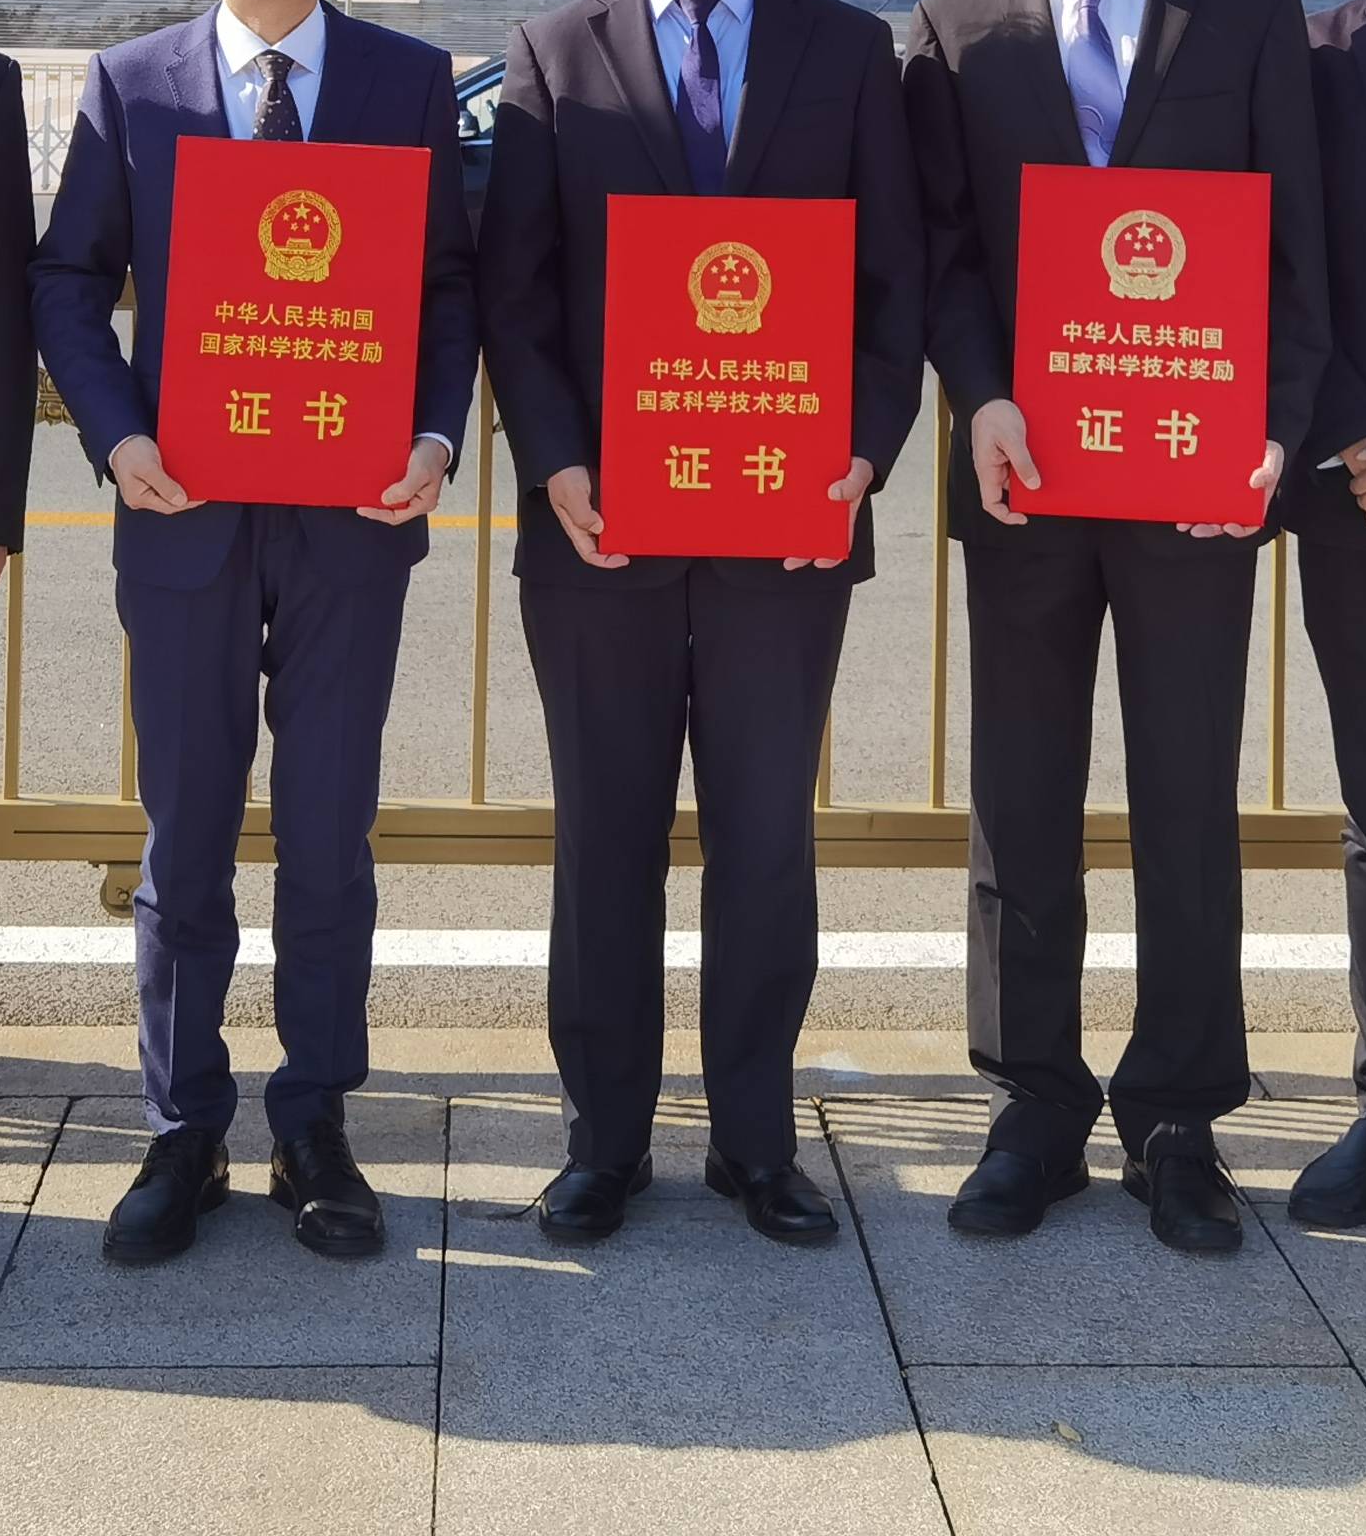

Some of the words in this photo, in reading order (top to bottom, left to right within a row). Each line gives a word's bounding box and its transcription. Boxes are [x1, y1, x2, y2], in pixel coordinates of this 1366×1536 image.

[215, 300, 374, 331] 中华人民共和国
[200, 332, 383, 364] 国家科学技术奖励
[1063, 319, 1223, 350] 中华人民共和国
[649, 357, 809, 383] 中华人民共和国
[1048, 351, 1235, 382] 国家科学技术奖励
[636, 389, 820, 415] 国家科学技术奖励
